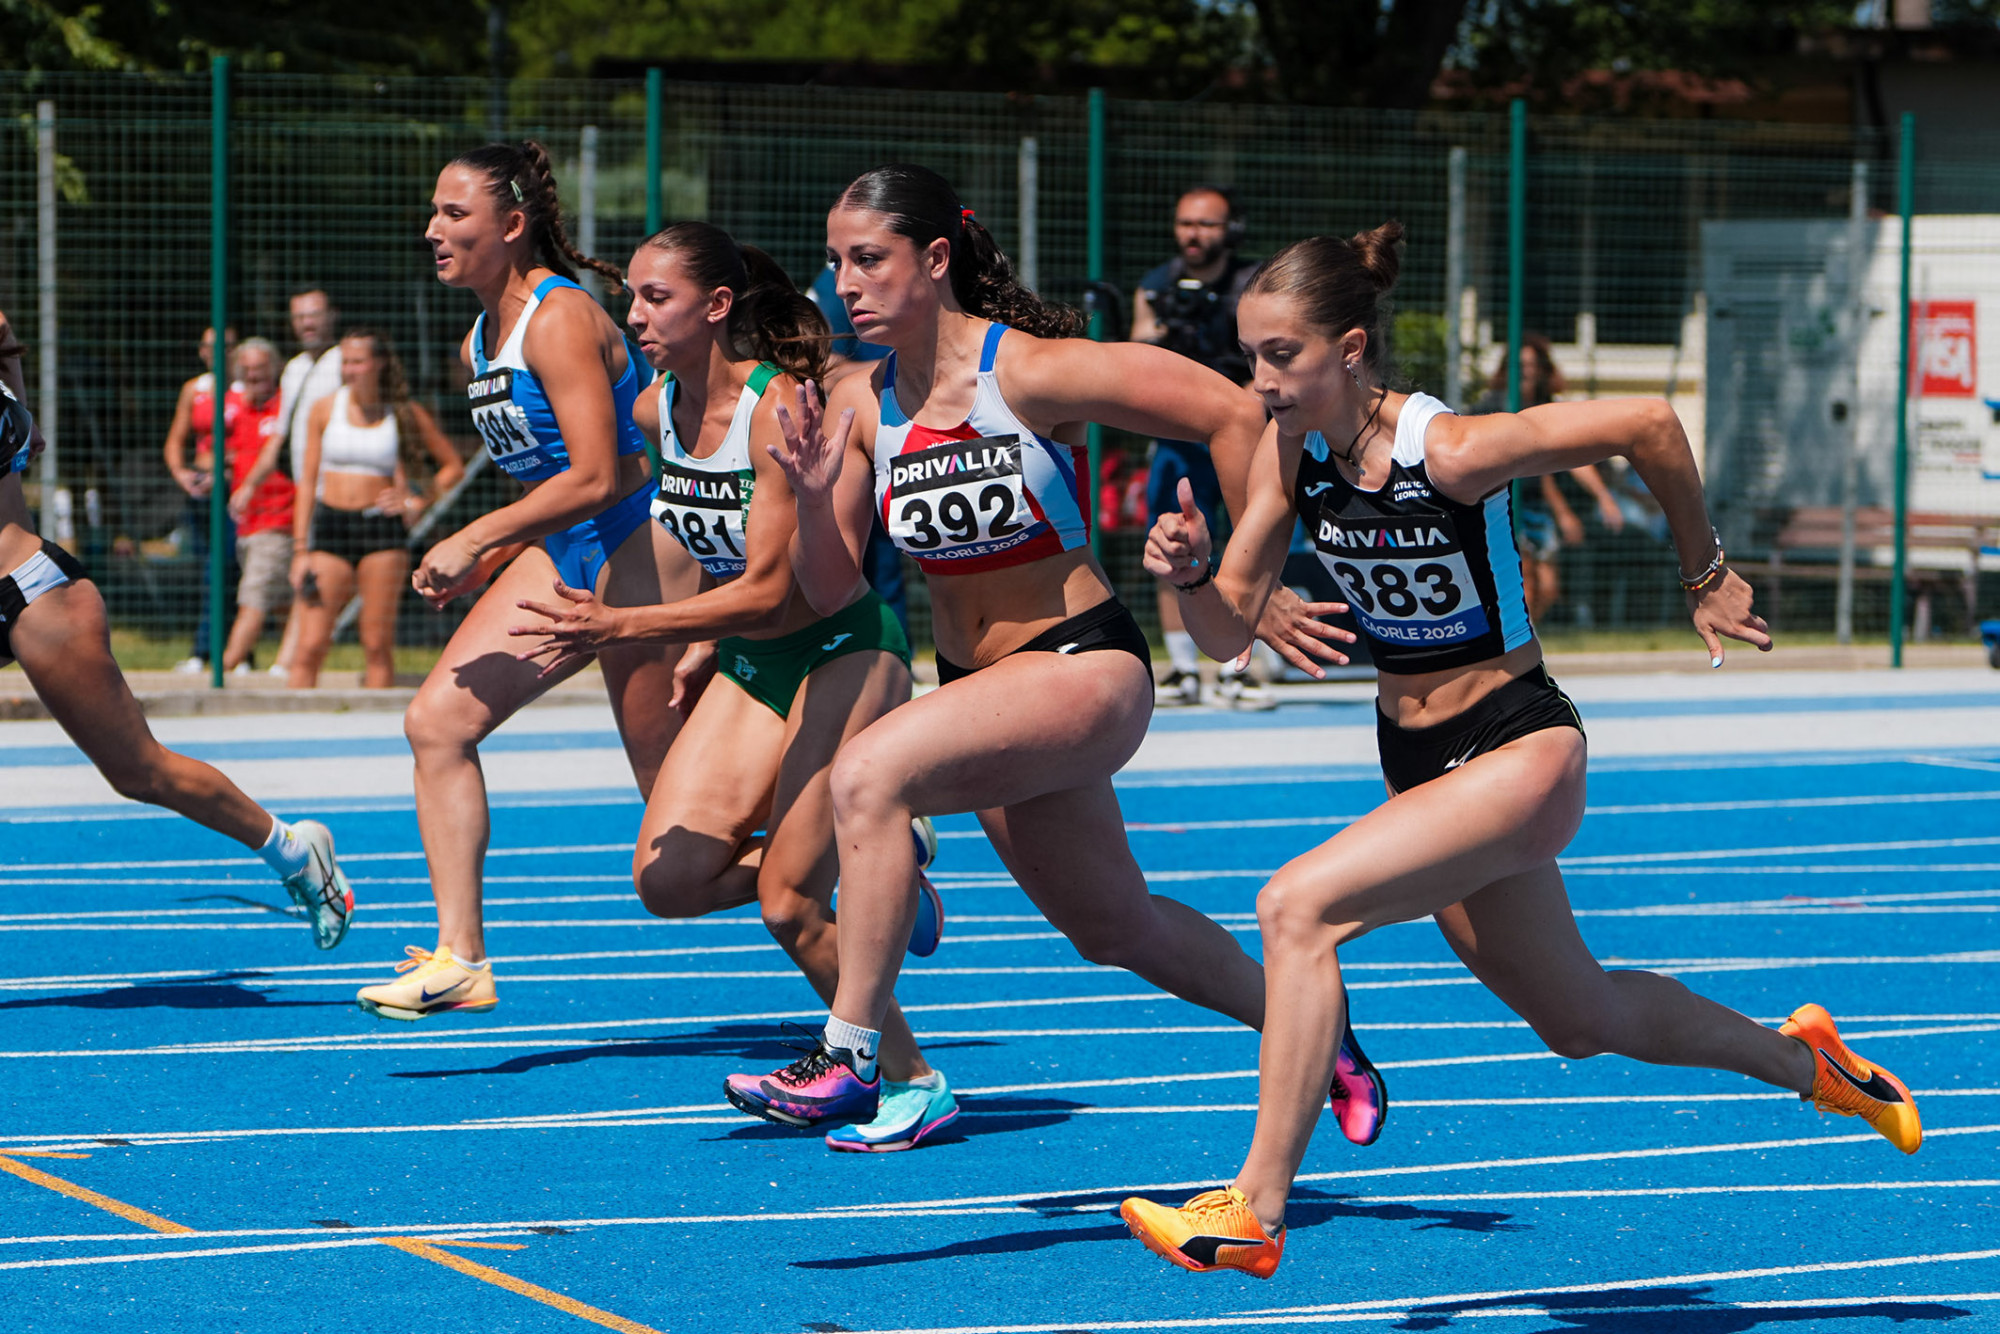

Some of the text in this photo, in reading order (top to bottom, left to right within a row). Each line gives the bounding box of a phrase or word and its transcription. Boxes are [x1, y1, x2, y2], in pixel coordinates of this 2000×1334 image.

[477, 406, 529, 456] 394
[500, 459, 525, 473] AORLE
[893, 446, 1013, 487] DRIVALIA
[661, 473, 736, 500] DRIVALIA
[901, 484, 1025, 549] 392
[990, 532, 1029, 552] 2026
[1318, 519, 1450, 548] DRIVALIA
[1333, 562, 1461, 618] 383
[1361, 616, 1467, 640] CAORLE 2026
